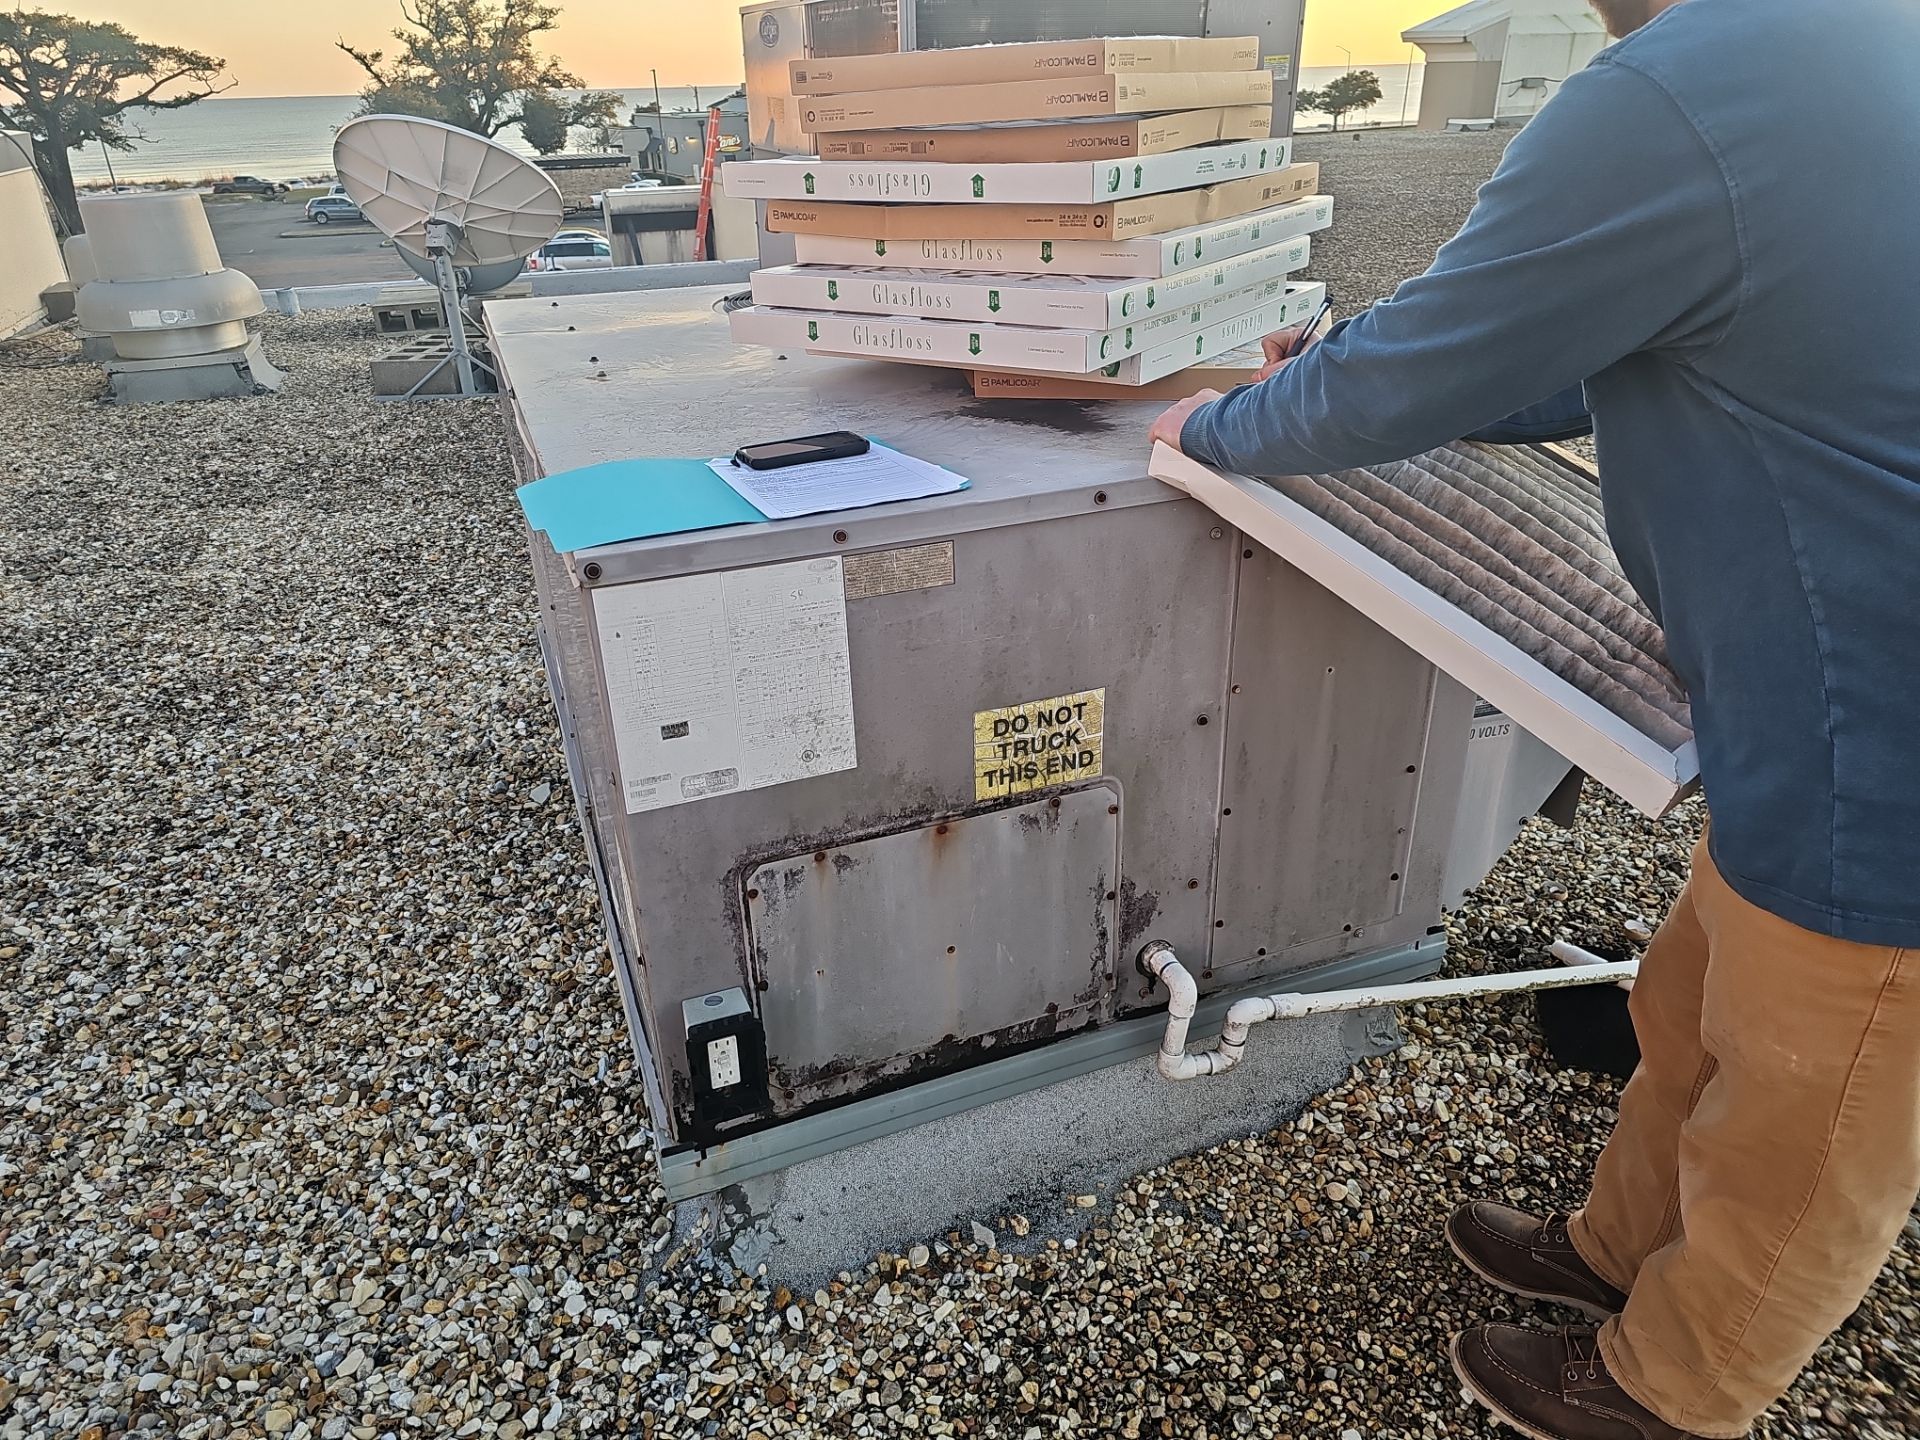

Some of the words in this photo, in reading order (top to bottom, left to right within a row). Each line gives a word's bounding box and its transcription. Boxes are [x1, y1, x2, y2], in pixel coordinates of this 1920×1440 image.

[1034, 56, 1086, 68] PAMLICOAIR
[1045, 93, 1098, 105] PAMLICOAIR
[1066, 136, 1119, 148] PAMLICOAIR
[849, 173, 931, 197] Glasfloss
[780, 211, 817, 223] PAMLICOAIR
[921, 240, 1003, 261] Glasfloss
[872, 283, 951, 309] Glasfloss
[1221, 312, 1263, 341] Glasfloss
[853, 325, 933, 351] Glasfloss
[990, 378, 1041, 388] PAMLICOAIR
[993, 714, 1029, 738] DO
[1037, 702, 1088, 729] NOT
[1478, 723, 1511, 739] VOLTS
[997, 728, 1082, 761] TRUCK
[983, 761, 1039, 788] THIS
[1046, 750, 1095, 776] END
